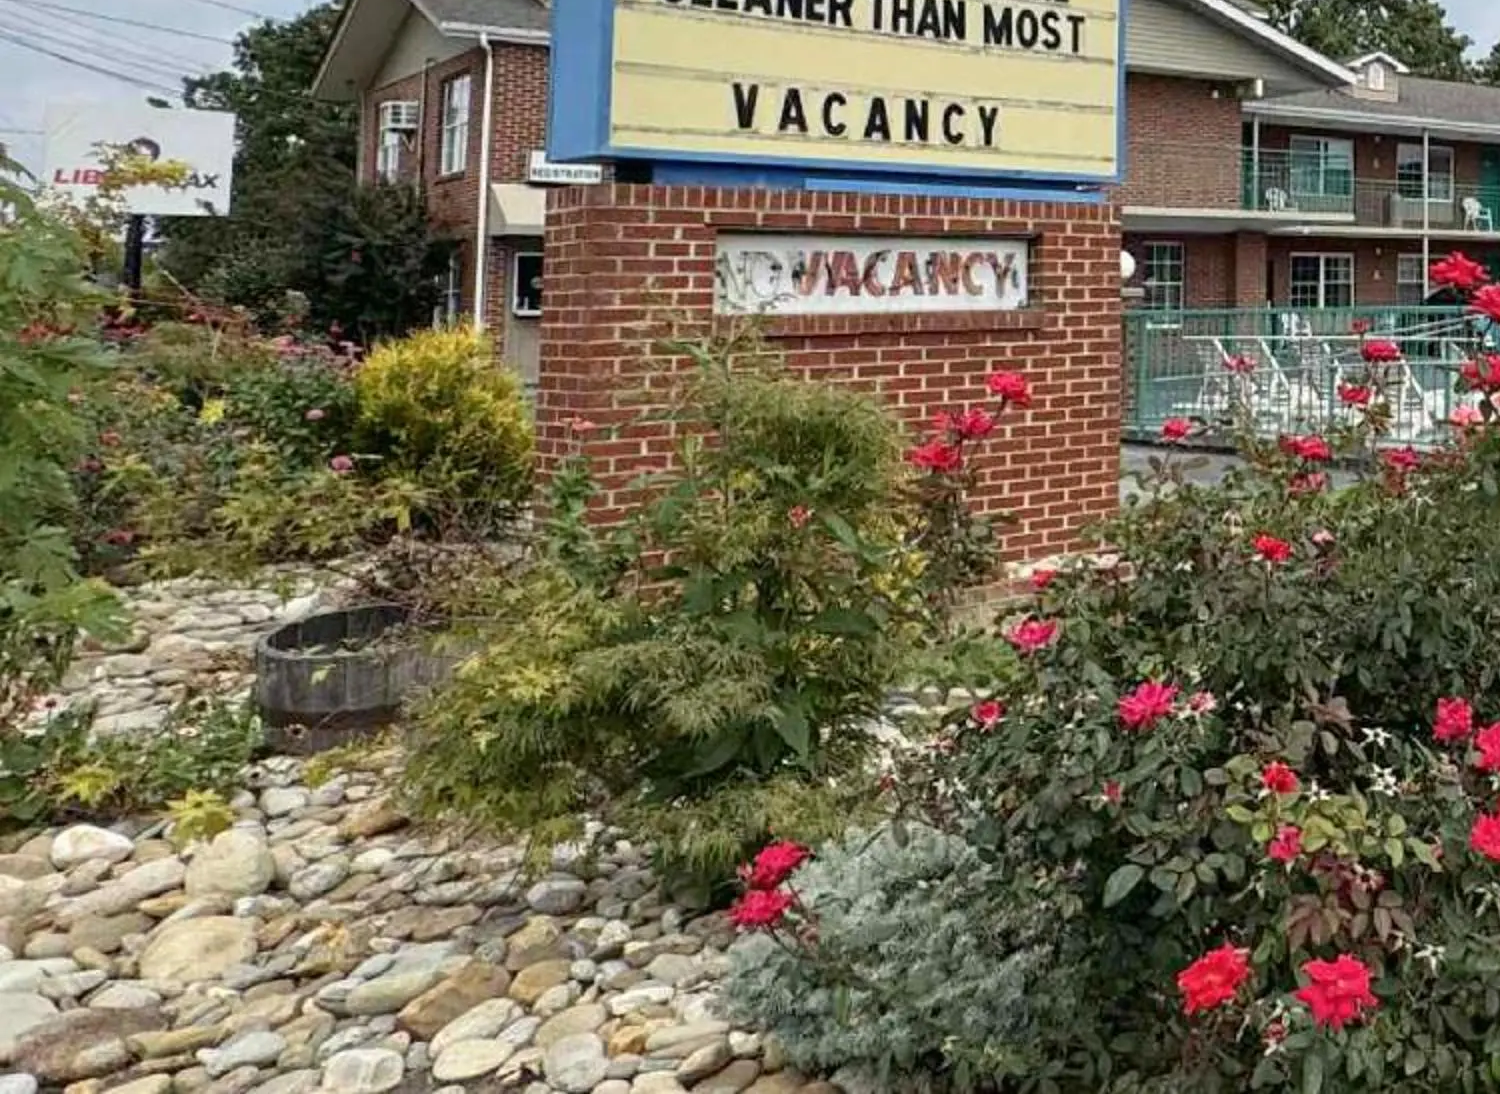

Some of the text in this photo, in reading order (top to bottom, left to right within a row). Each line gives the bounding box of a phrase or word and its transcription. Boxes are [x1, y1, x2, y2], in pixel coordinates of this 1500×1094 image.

[984, 4, 1085, 53] MOST
[732, 83, 998, 147] VACANCY
[792, 250, 1016, 297] VACANCY
